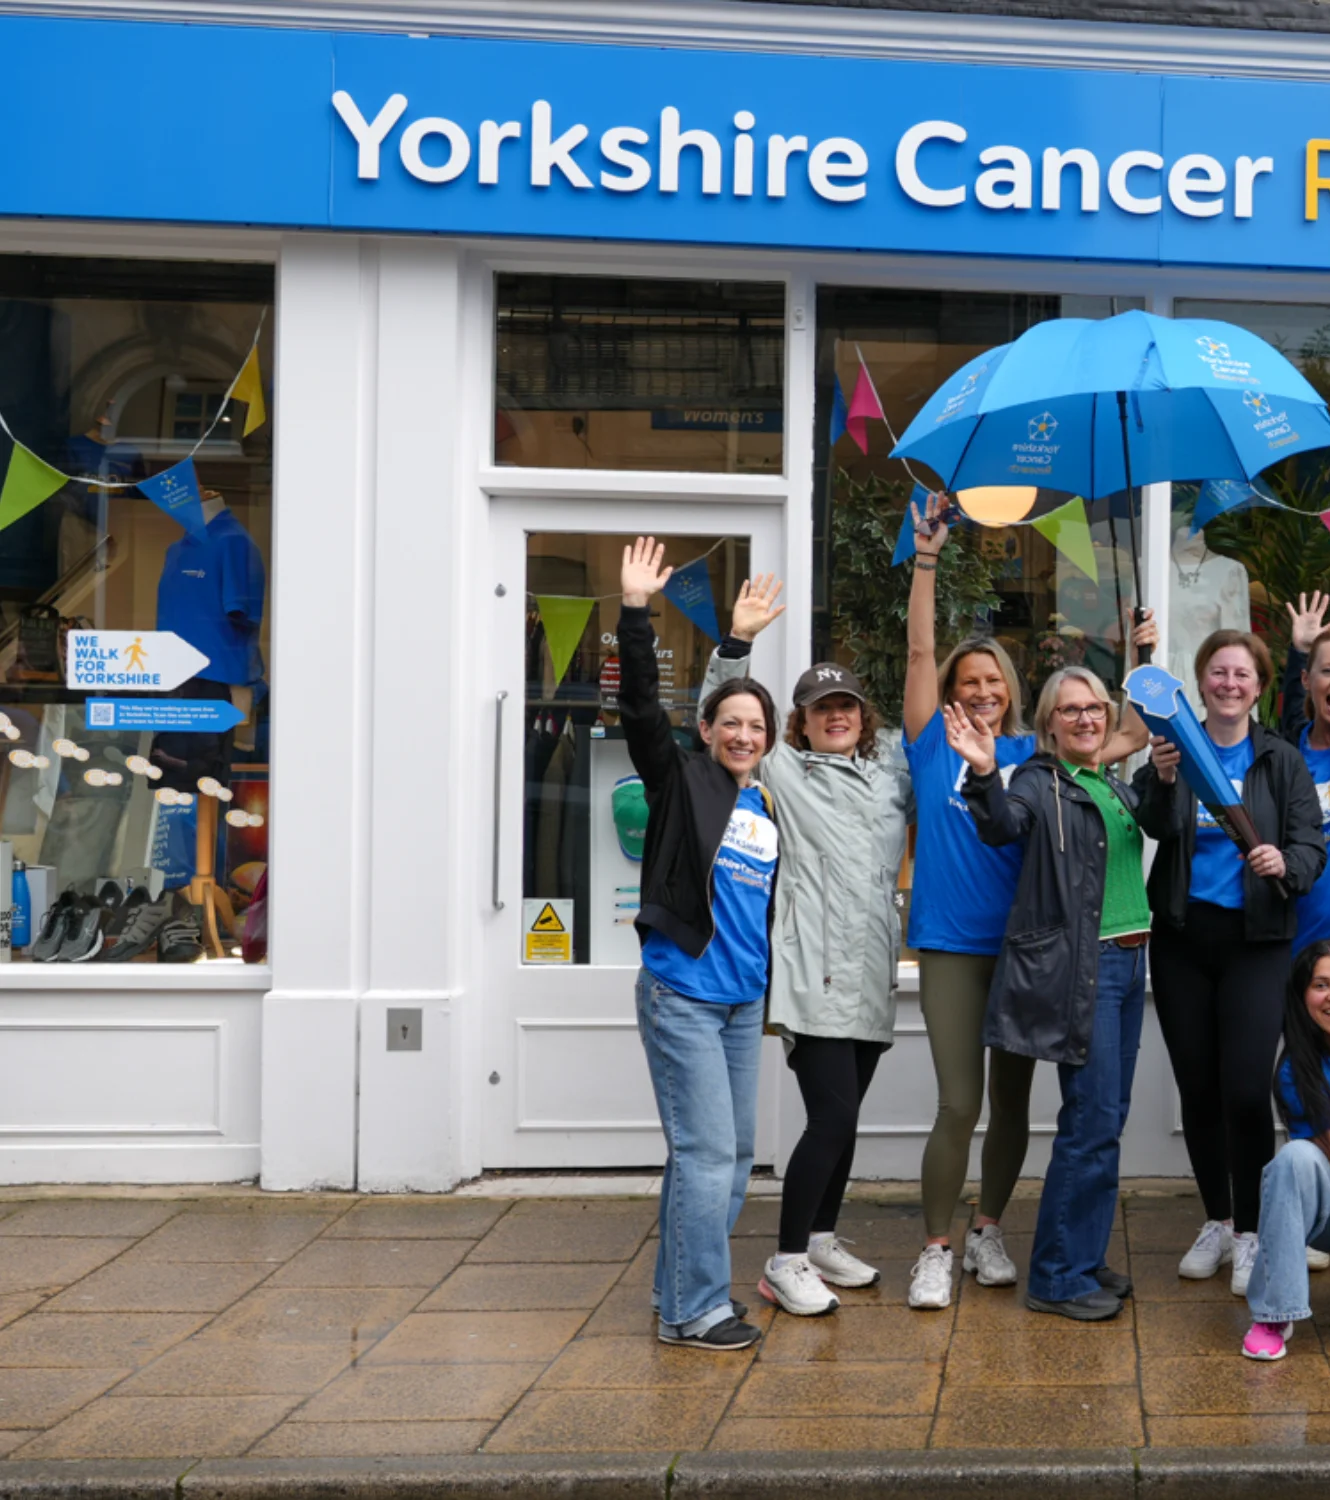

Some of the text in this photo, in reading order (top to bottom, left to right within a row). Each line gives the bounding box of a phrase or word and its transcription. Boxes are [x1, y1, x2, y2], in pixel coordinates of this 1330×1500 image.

[331, 90, 868, 202] Yorkshire
[894, 120, 1273, 218] Cancer
[1198, 354, 1252, 369] Yorkshire
[1210, 362, 1249, 376] Cancer
[683, 410, 765, 424] Women's
[74, 635, 99, 647] WE
[74, 648, 119, 660] WALK
[74, 660, 106, 672] FOR
[74, 673, 161, 685] YORKSHIRE
[816, 667, 843, 682] NY
